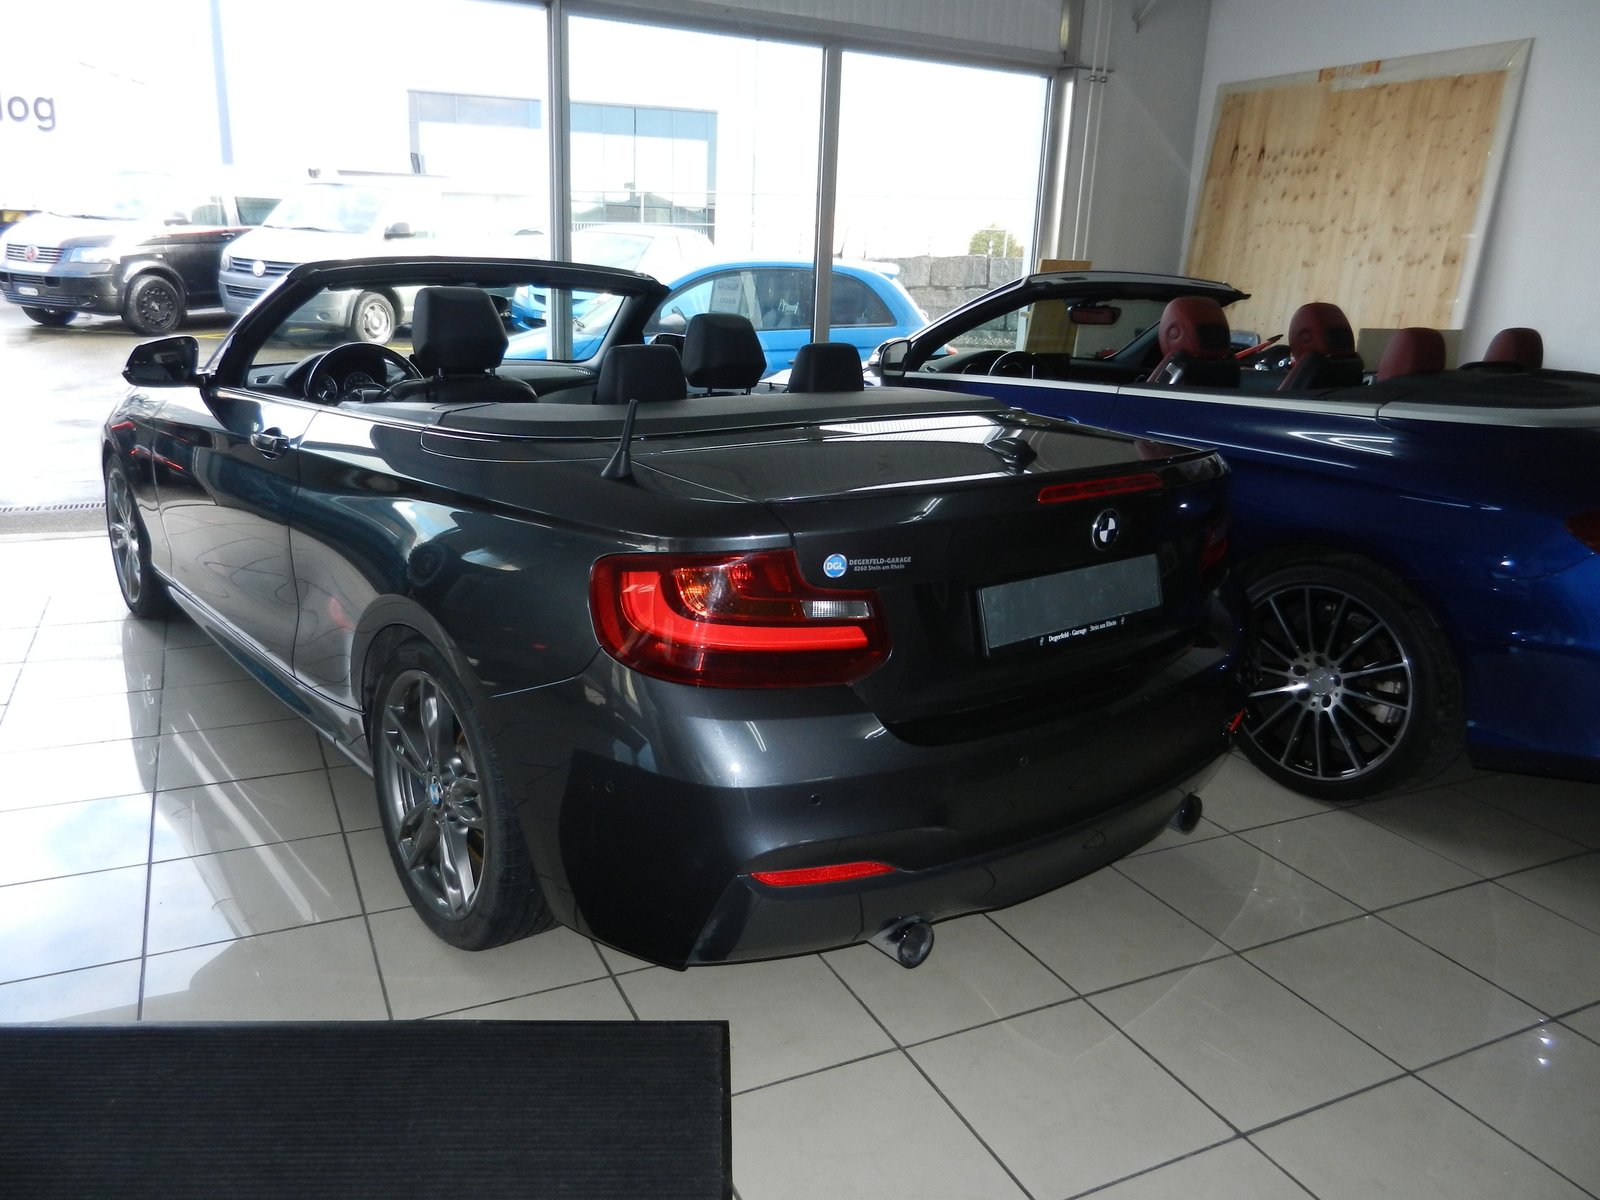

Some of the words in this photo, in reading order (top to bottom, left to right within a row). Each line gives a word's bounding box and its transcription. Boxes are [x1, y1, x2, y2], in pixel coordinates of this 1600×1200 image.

[827, 562, 844, 570] DGL
[1049, 631, 1069, 641] Degerfeld
[1072, 628, 1087, 636] Garage
